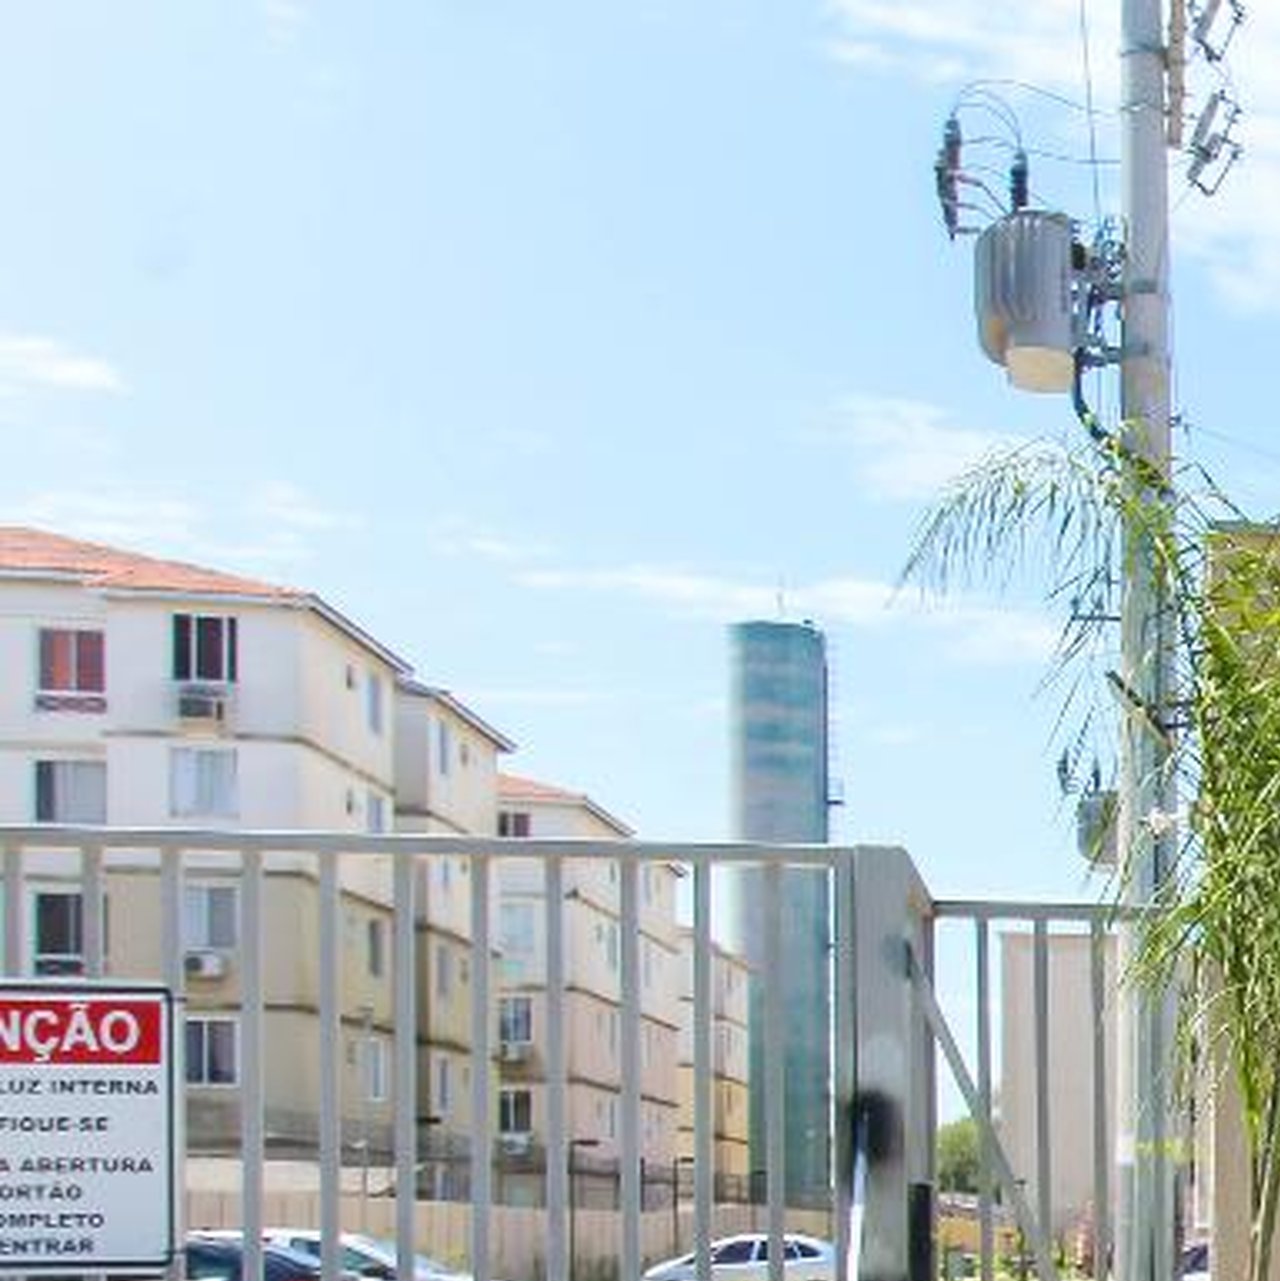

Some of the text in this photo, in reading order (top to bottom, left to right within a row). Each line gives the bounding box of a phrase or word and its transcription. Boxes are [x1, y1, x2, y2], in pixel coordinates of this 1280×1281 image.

[0, 1002, 140, 1062] NÇÃO
[51, 1079, 159, 1096] INTERNA
[19, 1156, 154, 1174] ABERTURA
